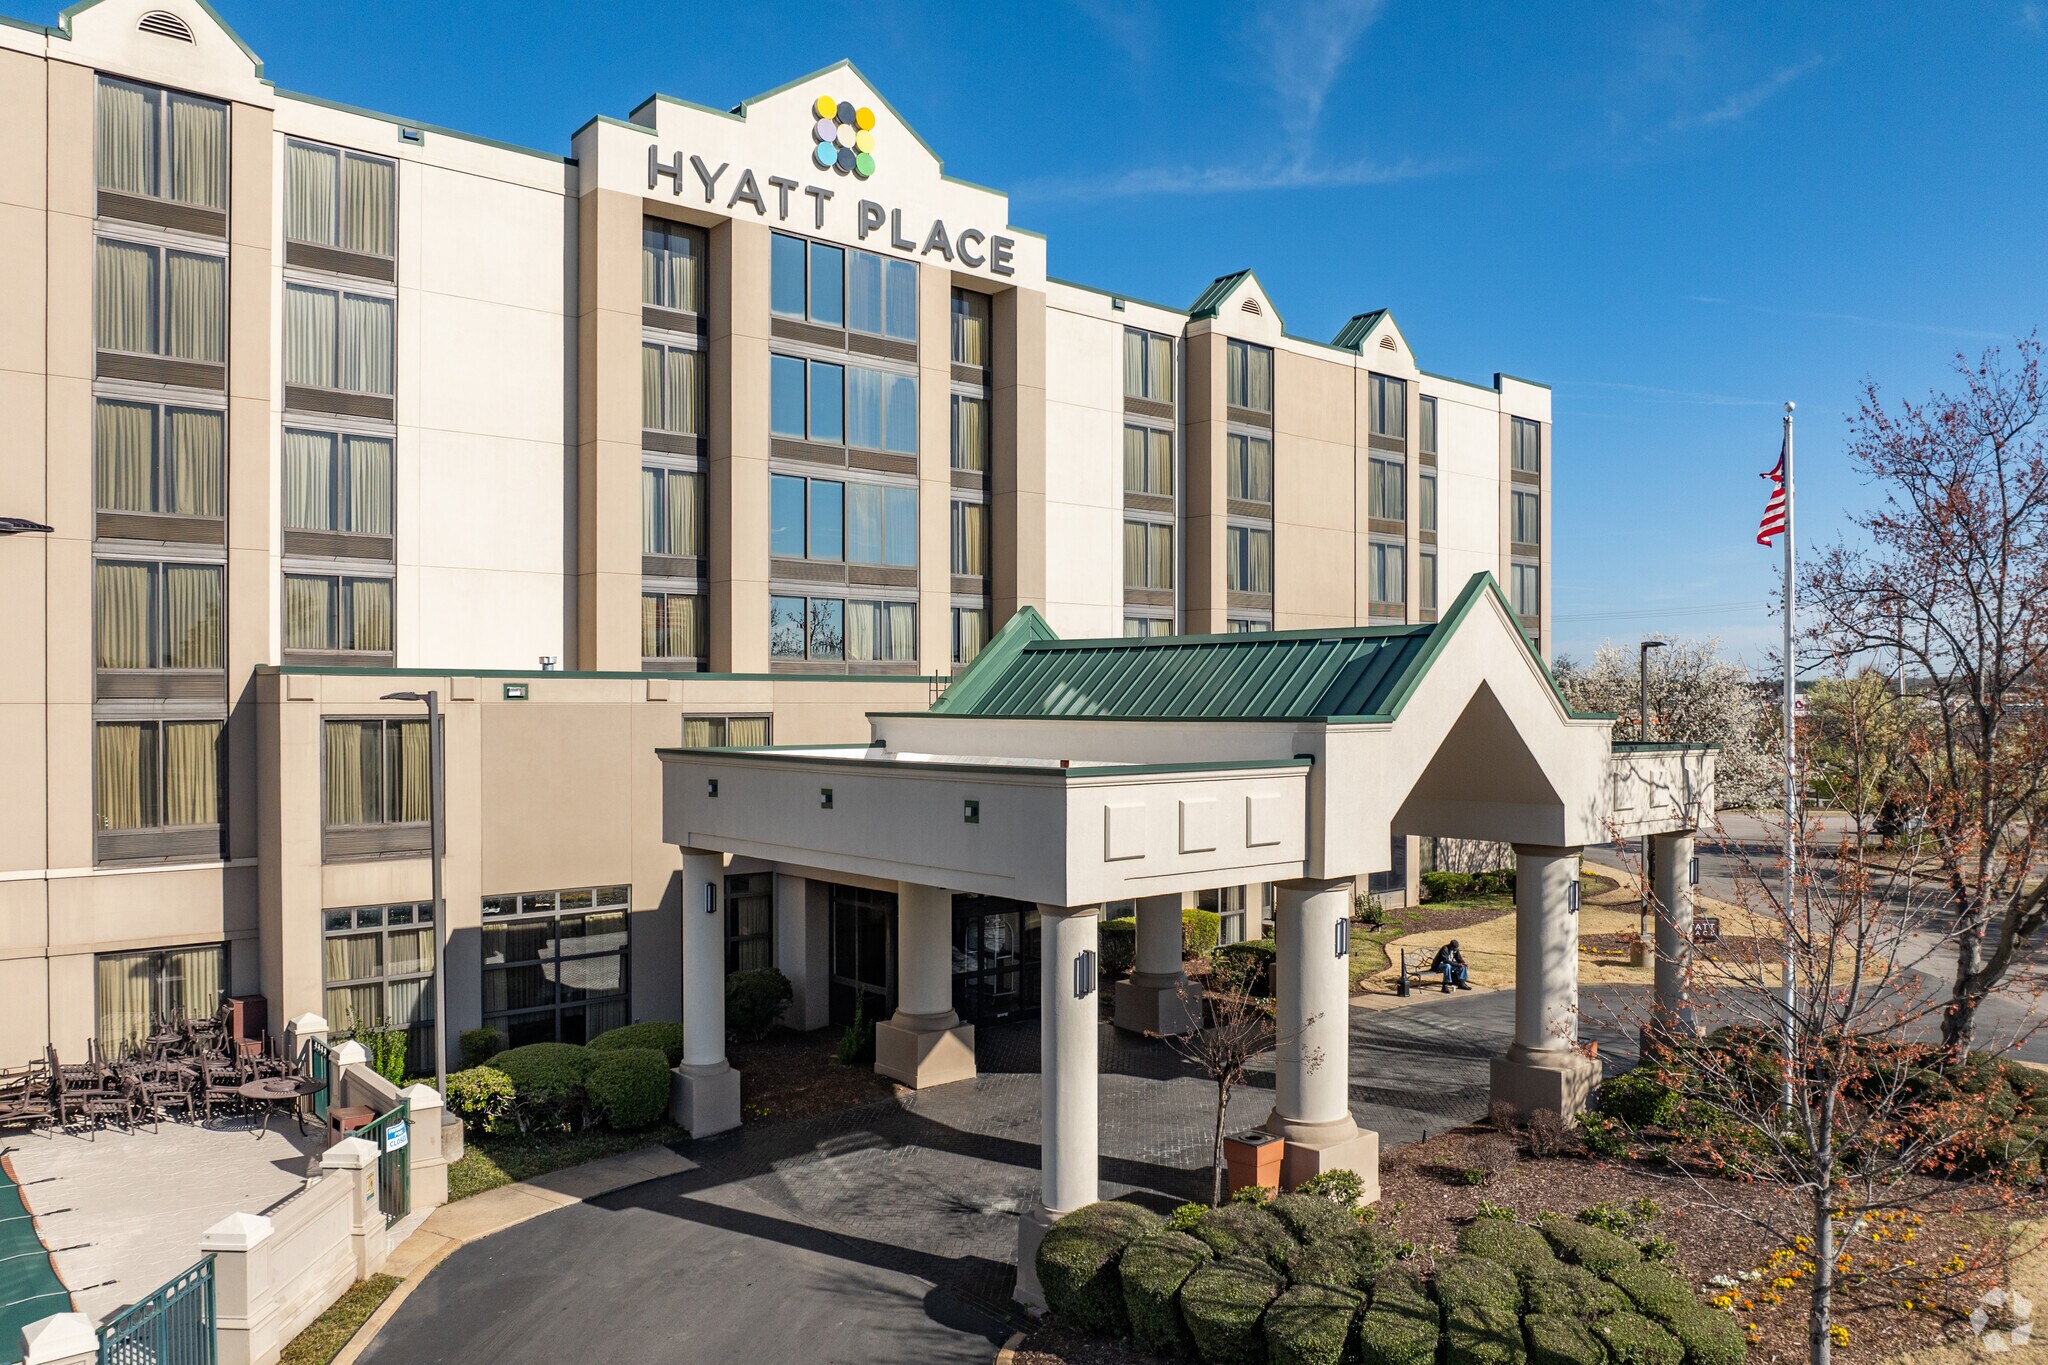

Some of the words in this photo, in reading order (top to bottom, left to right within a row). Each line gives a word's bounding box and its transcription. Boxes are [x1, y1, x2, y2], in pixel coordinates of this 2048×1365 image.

[648, 144, 834, 229] HYATT
[858, 199, 1015, 276] PLACE
[390, 1135, 406, 1147] CLOS
